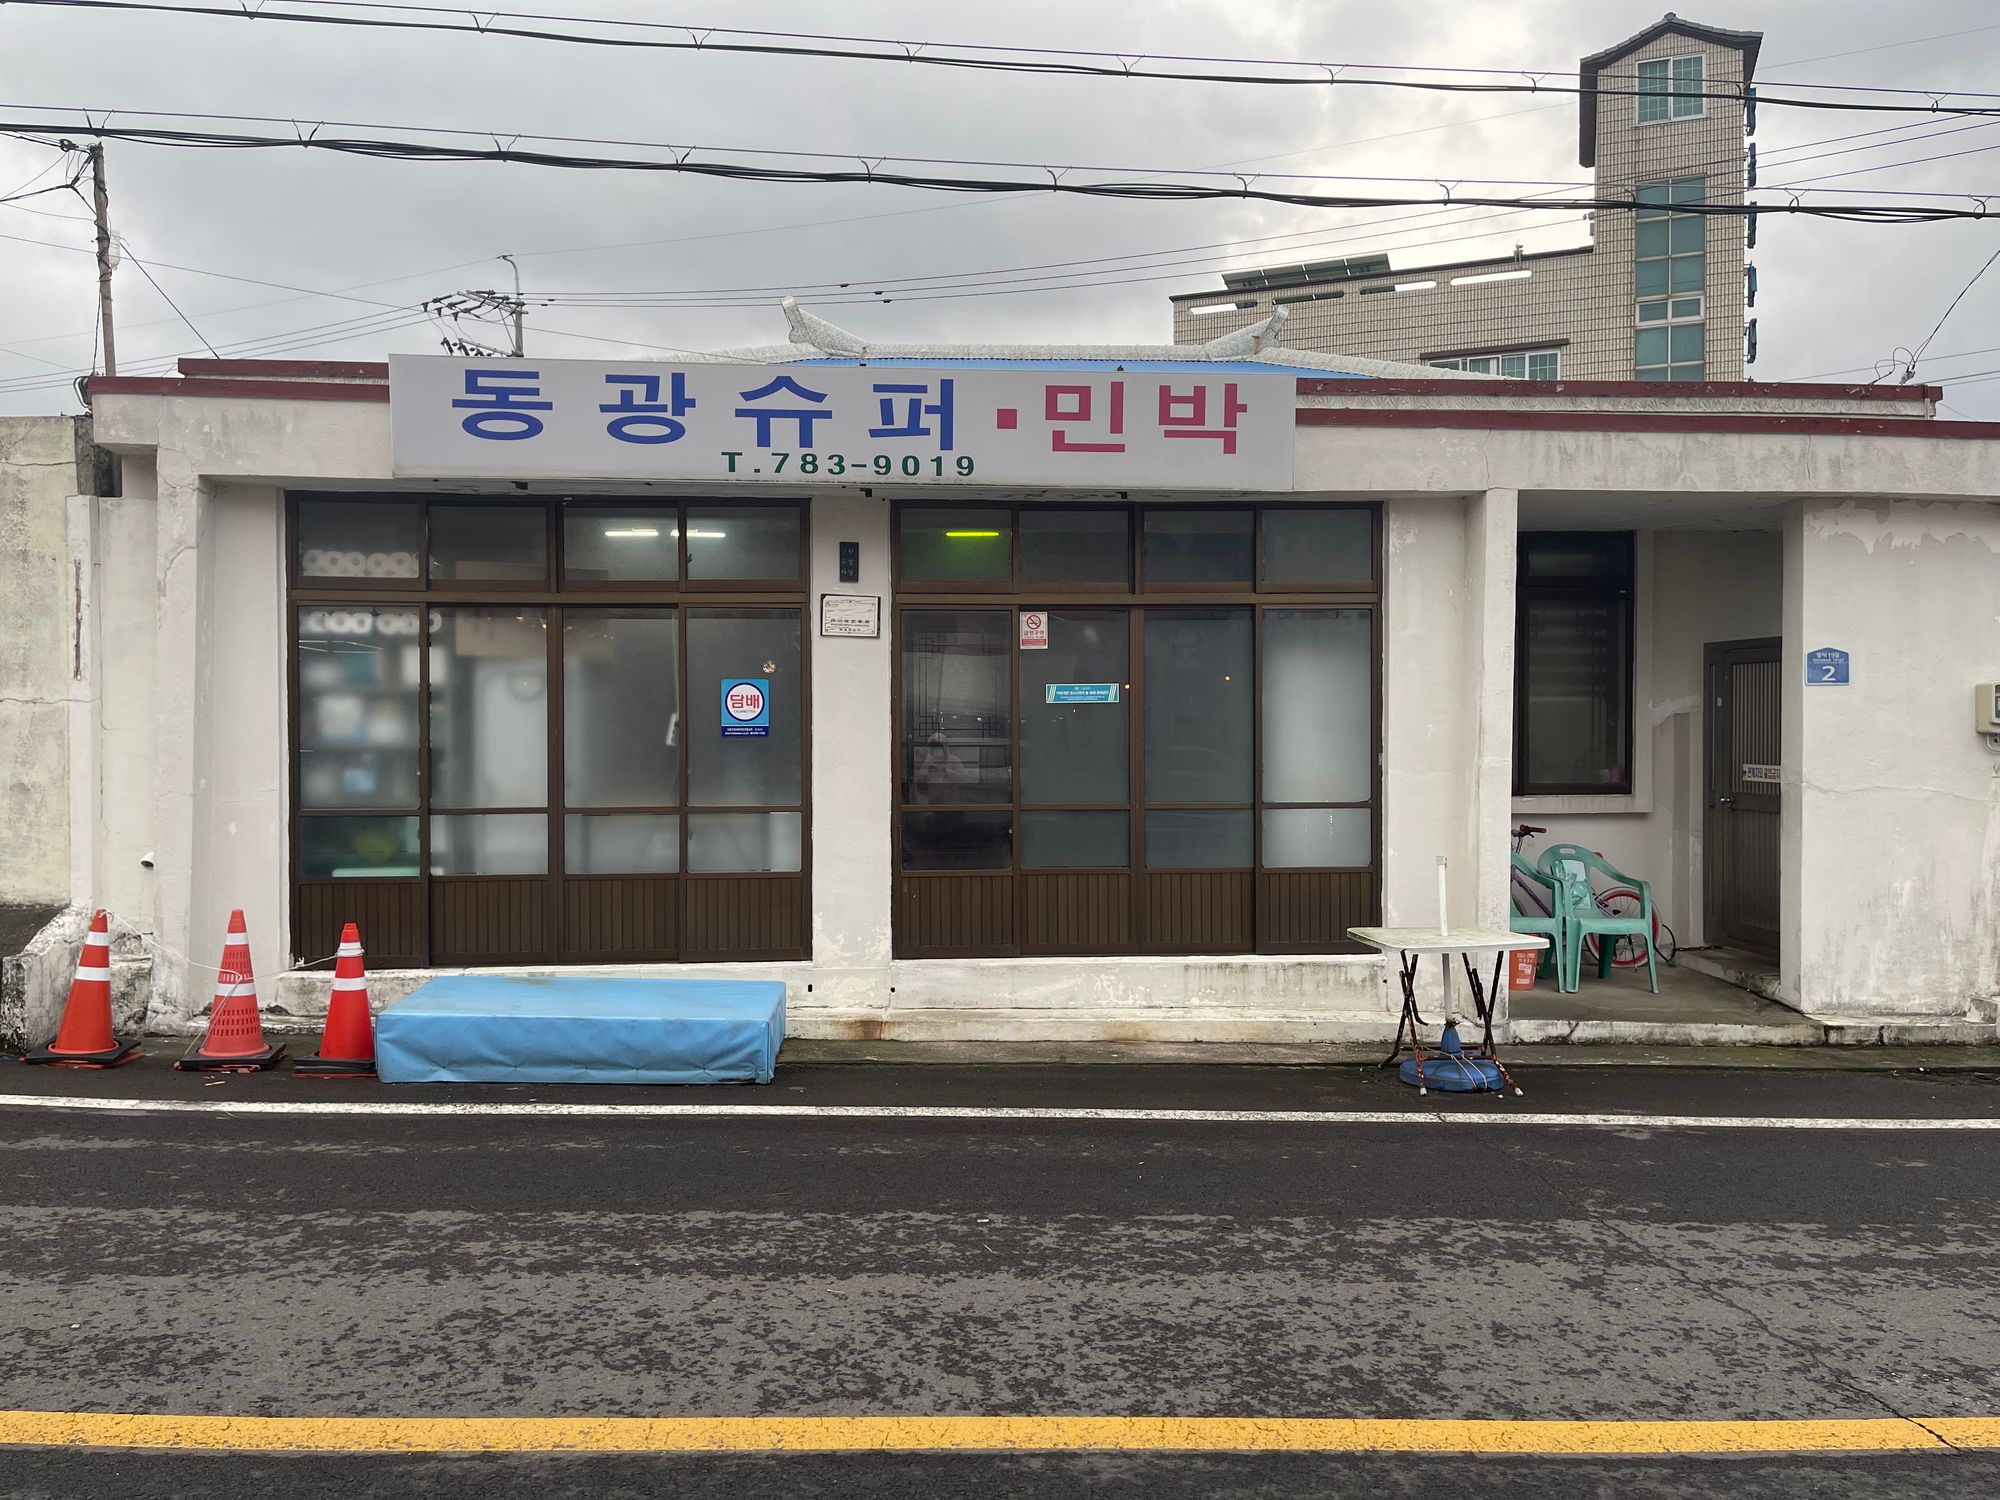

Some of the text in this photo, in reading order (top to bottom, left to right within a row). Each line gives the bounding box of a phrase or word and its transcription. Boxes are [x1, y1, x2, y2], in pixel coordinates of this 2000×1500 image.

[721, 451, 975, 477] T.783-9019
[1822, 665, 1836, 681] 2
[730, 694, 760, 709] 담배
